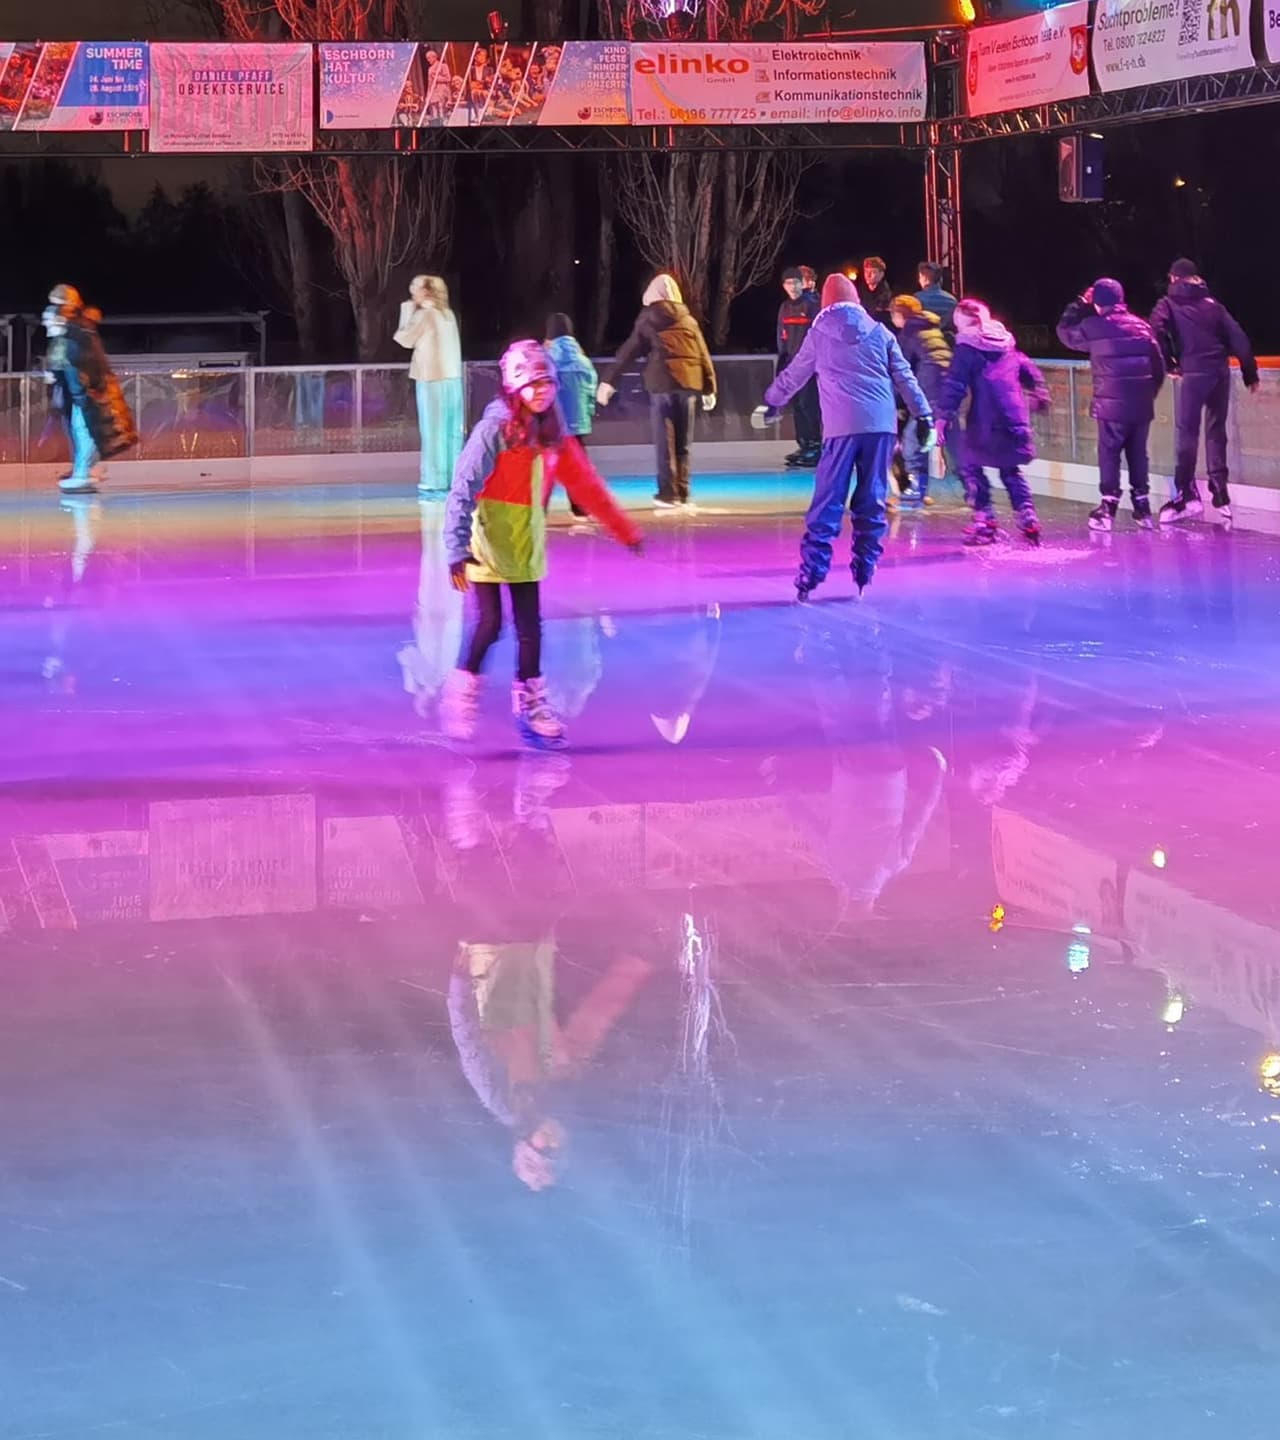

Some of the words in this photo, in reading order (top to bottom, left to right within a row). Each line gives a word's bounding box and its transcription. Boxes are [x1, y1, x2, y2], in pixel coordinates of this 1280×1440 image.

[86, 48, 142, 58] SUMMER
[324, 50, 395, 60] ESCHBORN
[603, 46, 626, 54] KINO
[599, 55, 626, 63] FESTE
[772, 50, 862, 61] Elektrotechnik
[112, 59, 143, 70] TIME
[324, 62, 350, 72] HAT
[635, 54, 749, 74] elinko
[194, 71, 233, 81] DANIEL
[238, 71, 270, 81] PFAFF
[325, 73, 375, 83] KULTUR
[589, 72, 626, 80] THEATER
[774, 69, 897, 81] Informationstechnik
[178, 83, 285, 95] OBJEKTSERVICE
[774, 90, 922, 101] Kommunikationstechnik
[637, 109, 665, 120] Tel.:
[670, 109, 706, 120] 06196
[711, 108, 756, 119] 777725
[771, 108, 811, 119] email:
[815, 106, 921, 120] info@elinko.info
